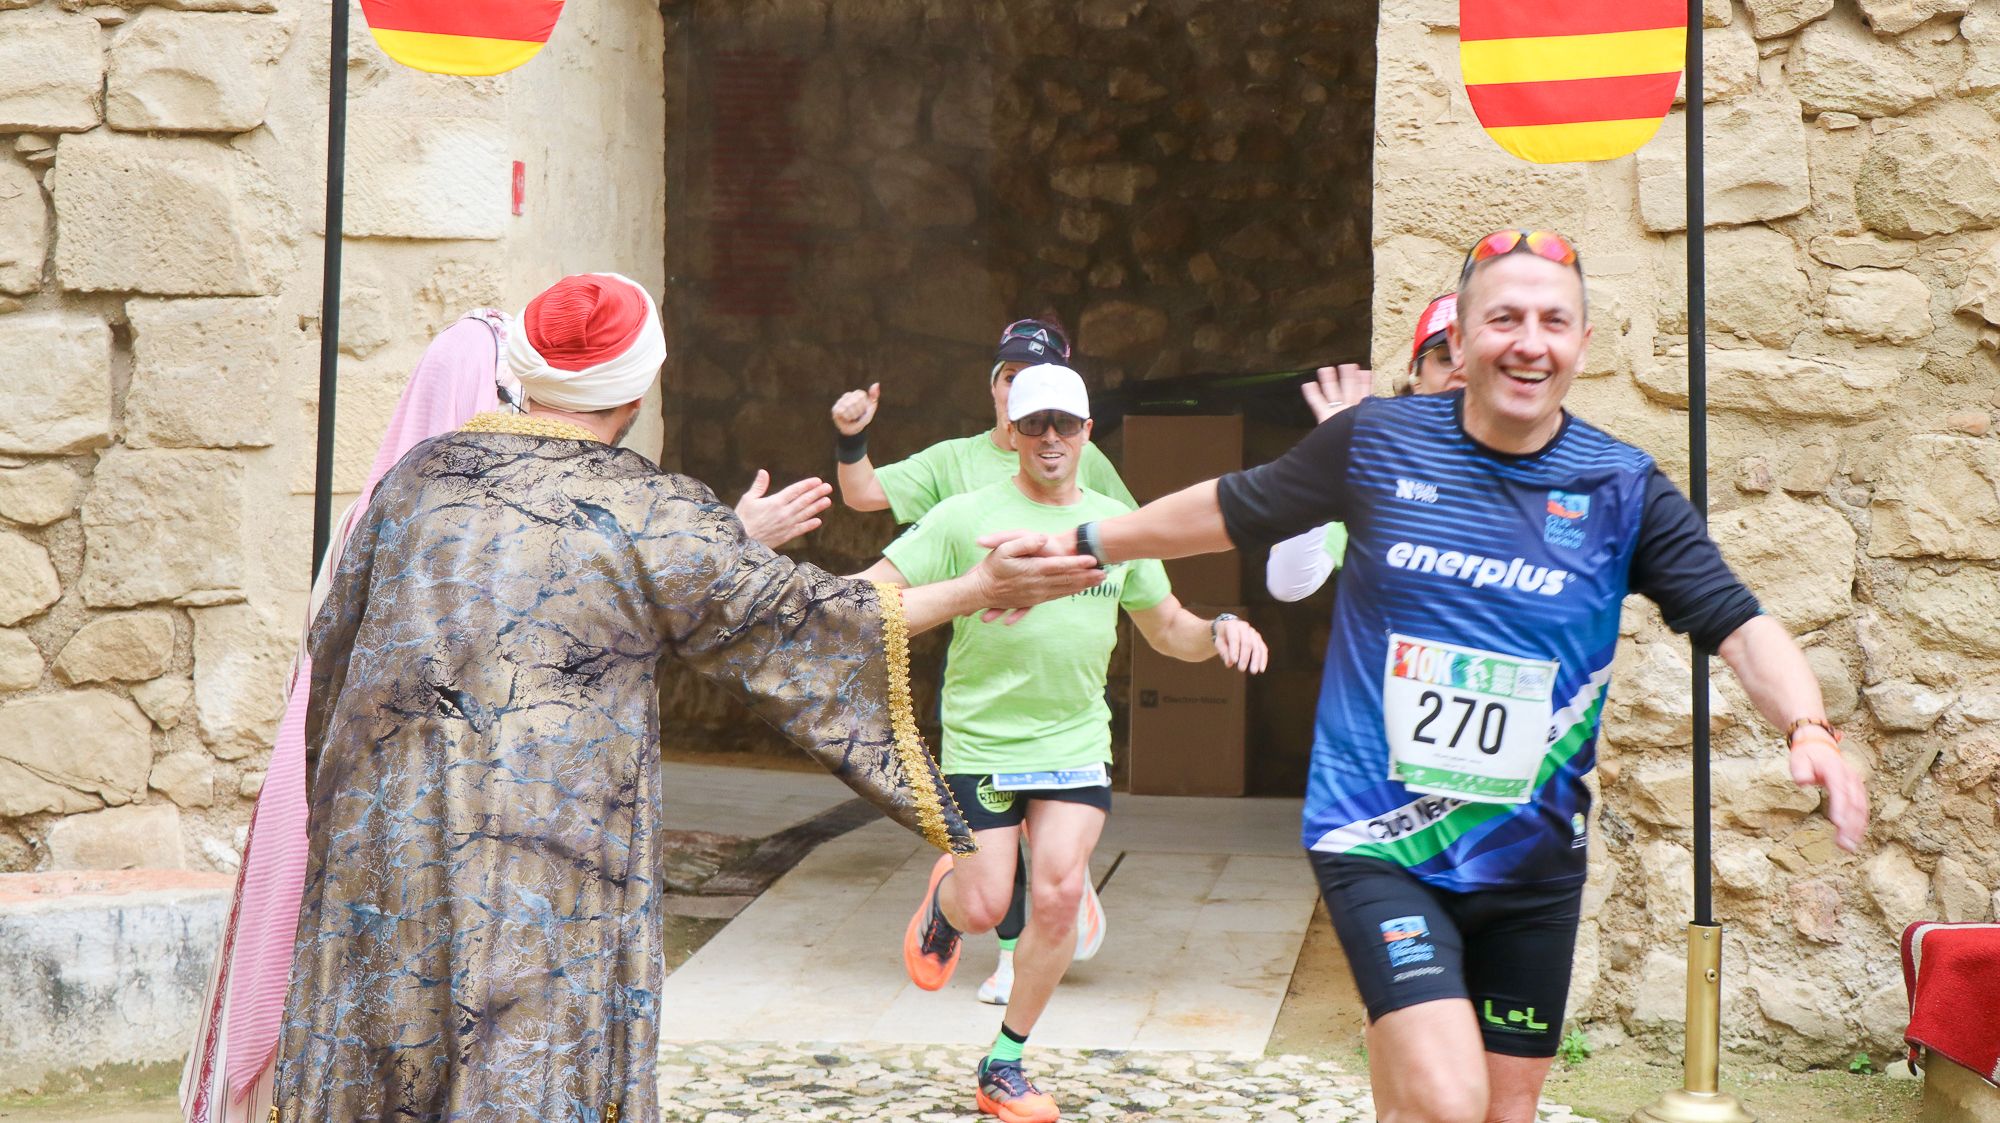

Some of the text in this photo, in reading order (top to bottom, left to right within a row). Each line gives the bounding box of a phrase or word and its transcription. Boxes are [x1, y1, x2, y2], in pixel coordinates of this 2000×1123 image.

[1386, 541, 1568, 596] enerplus
[1402, 643, 1457, 688] 10K
[1413, 690, 1507, 755] 270
